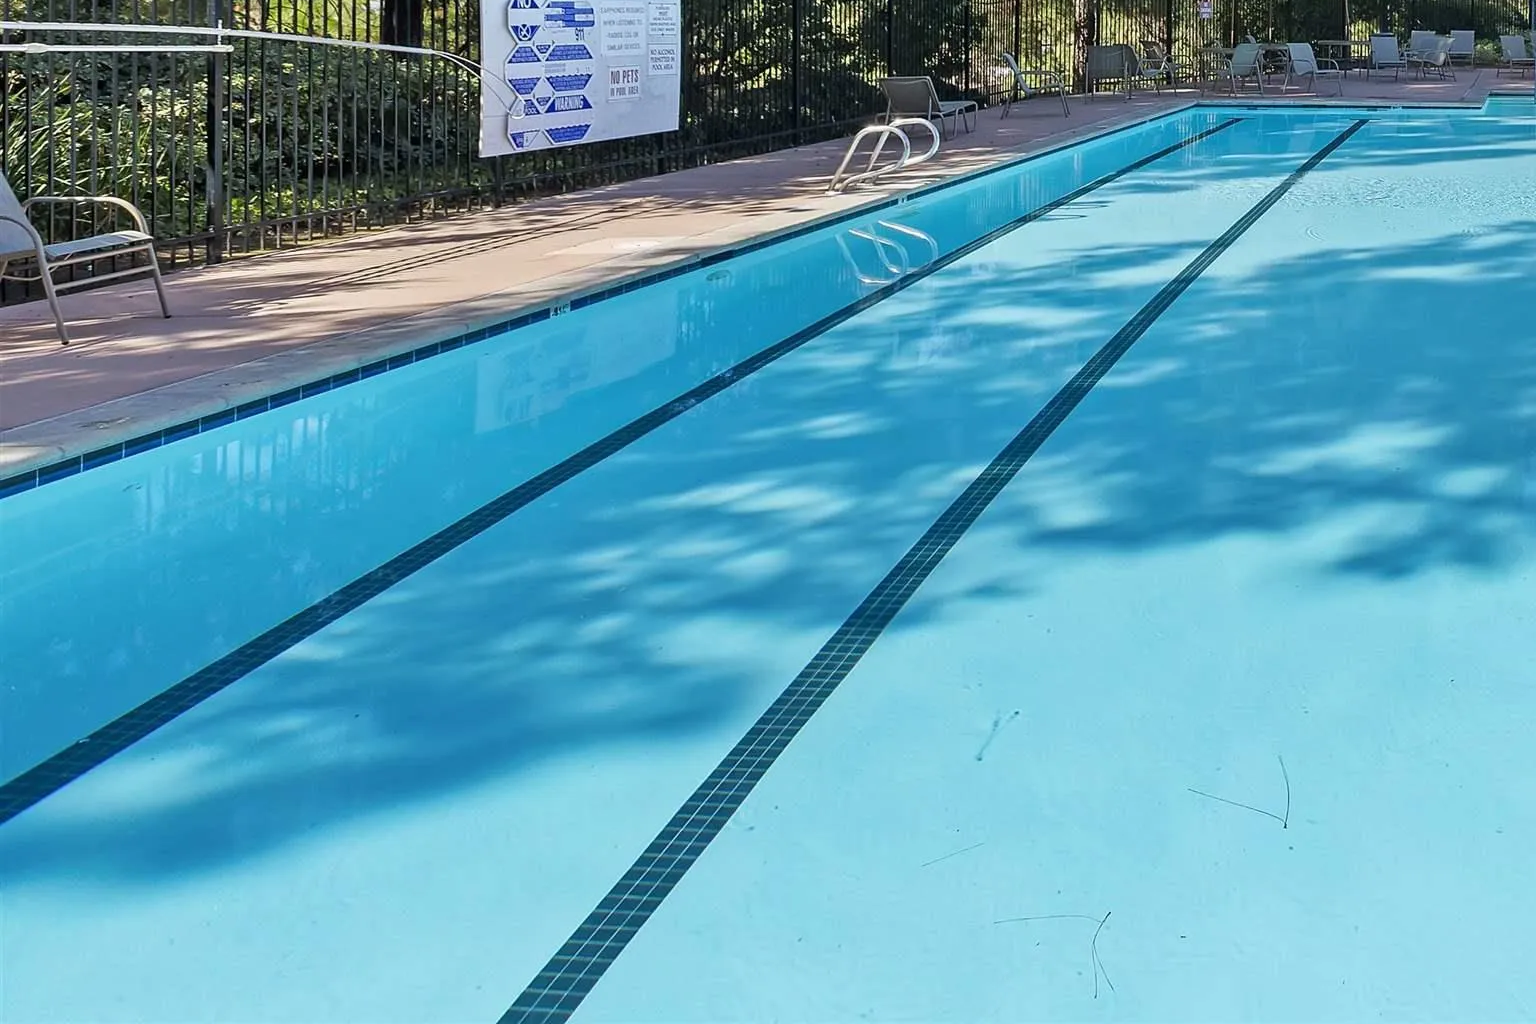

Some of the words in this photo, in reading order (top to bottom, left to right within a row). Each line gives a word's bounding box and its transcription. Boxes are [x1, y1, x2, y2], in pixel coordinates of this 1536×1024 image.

[575, 27, 584, 41] 911
[611, 70, 620, 84] NO
[622, 69, 639, 84] PETS
[610, 87, 615, 96] IN
[616, 87, 626, 96] POOL
[628, 86, 639, 95] AREA
[555, 95, 583, 111] WARNING
